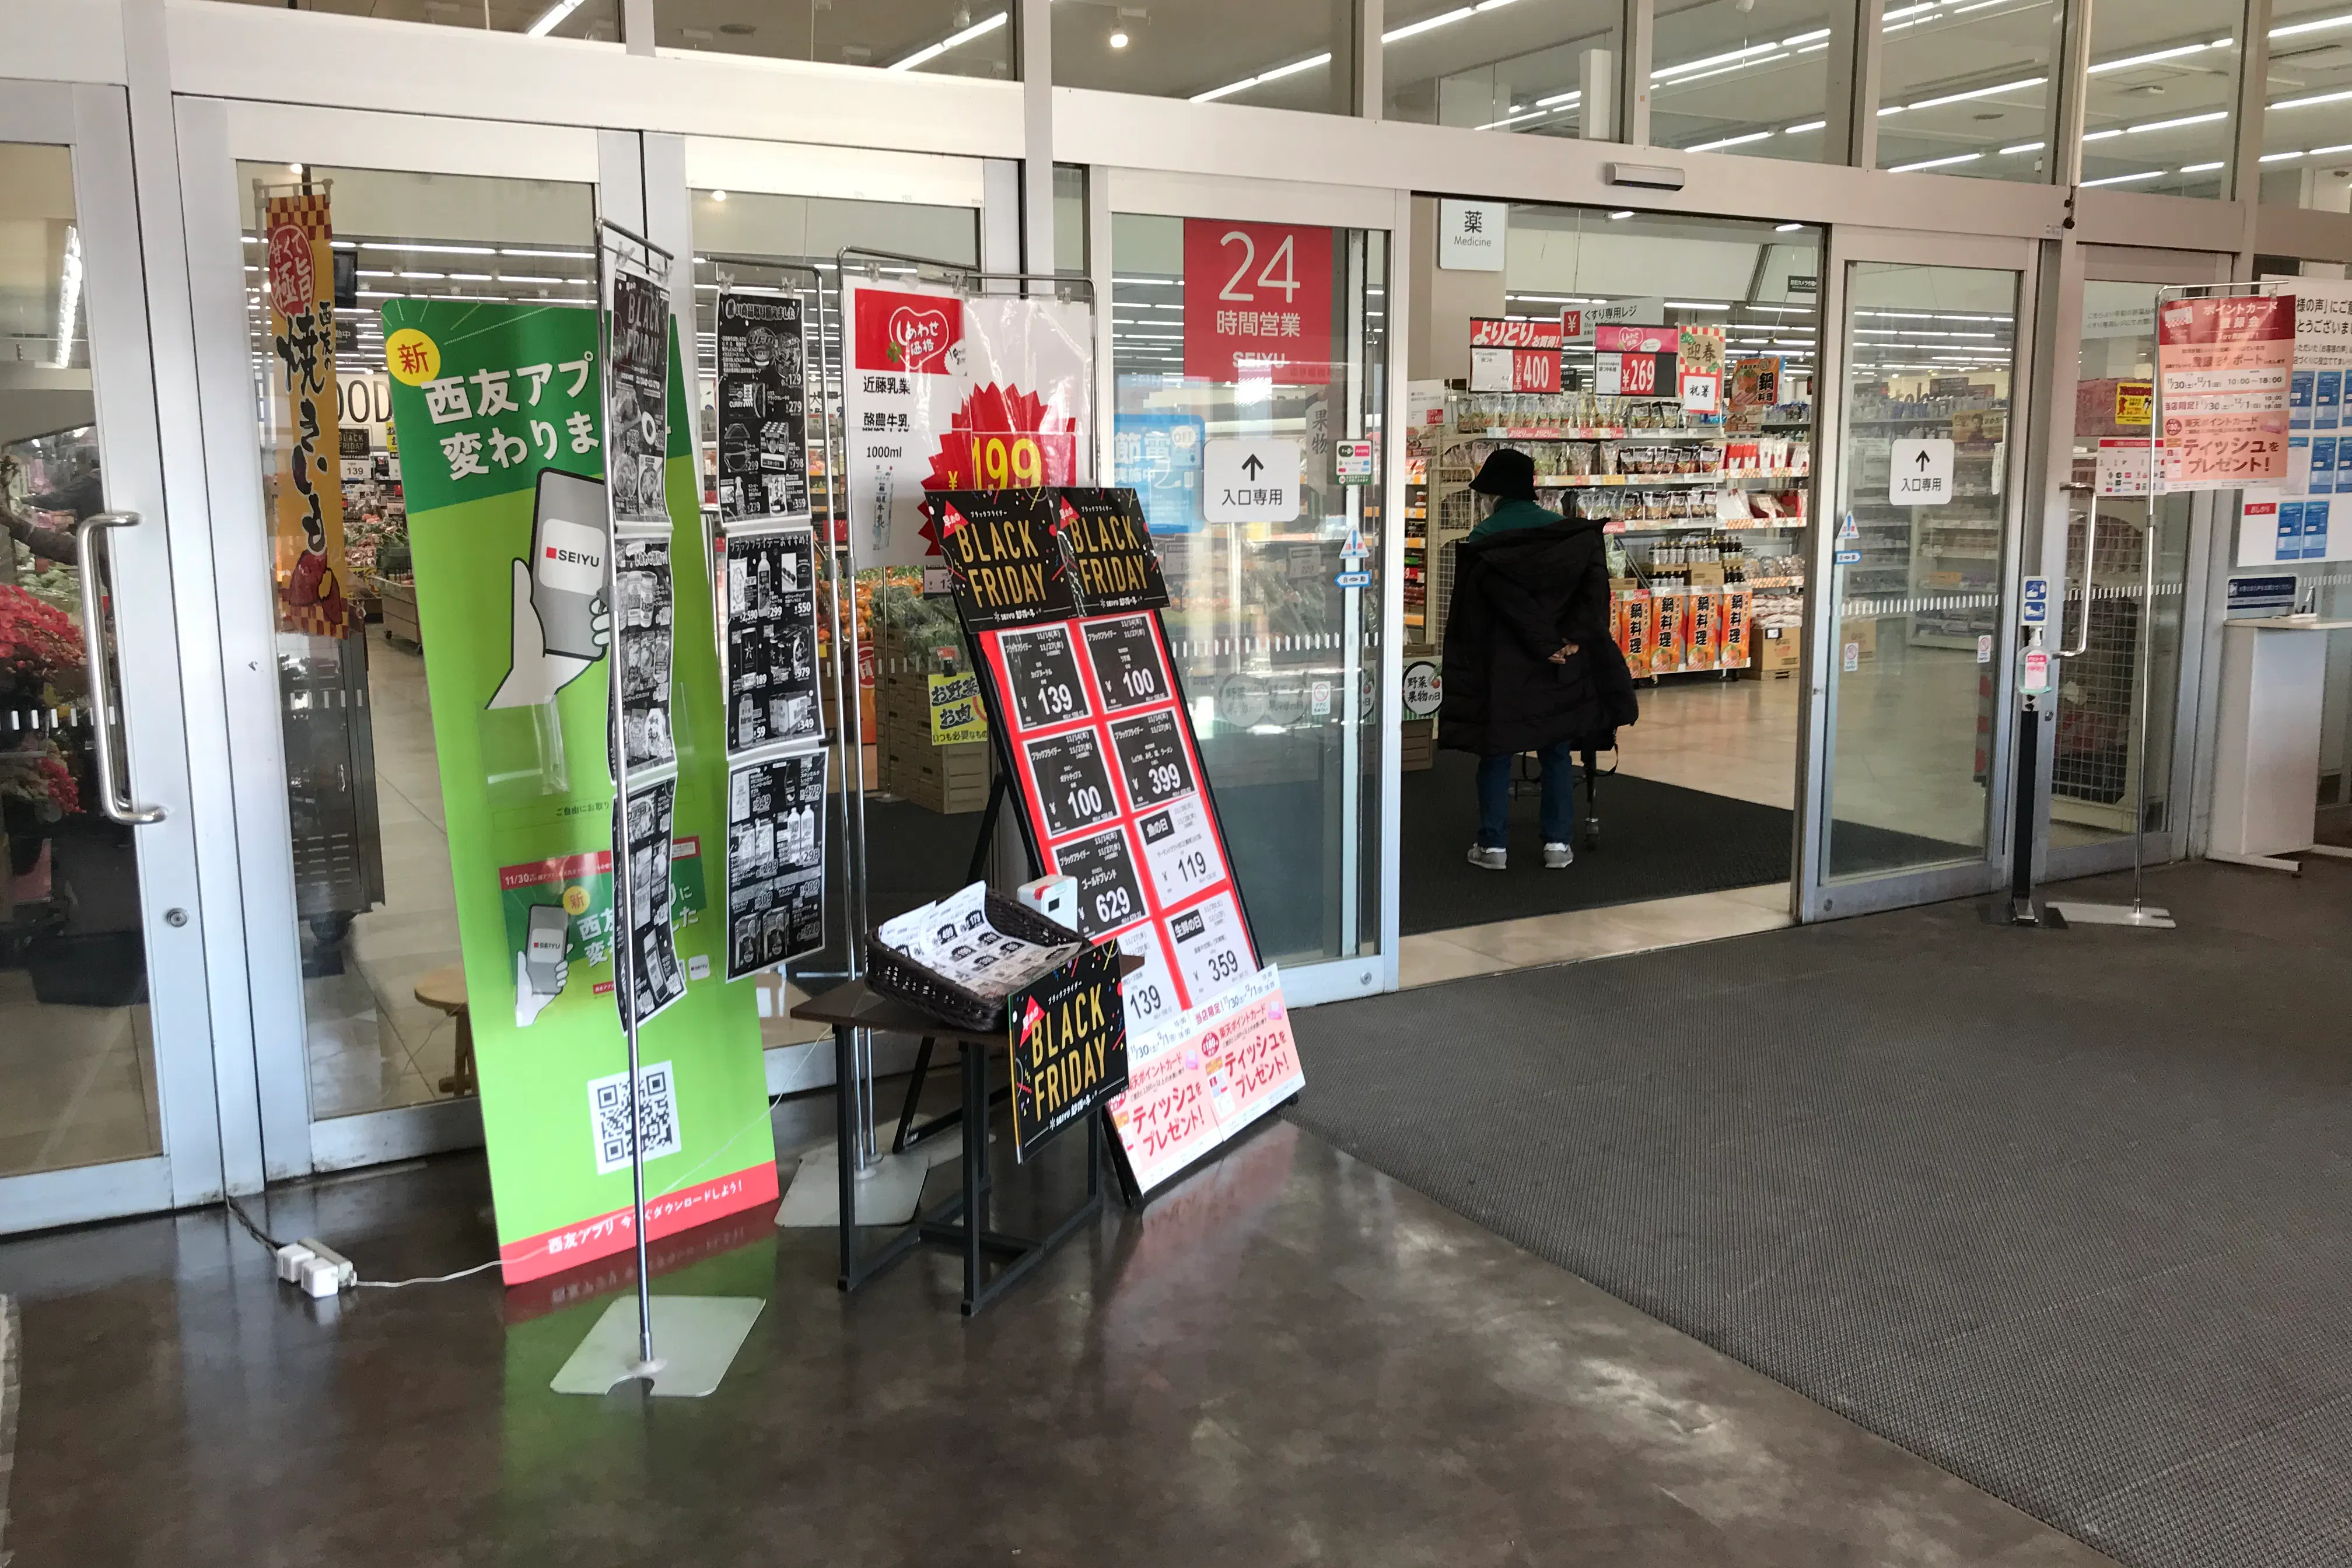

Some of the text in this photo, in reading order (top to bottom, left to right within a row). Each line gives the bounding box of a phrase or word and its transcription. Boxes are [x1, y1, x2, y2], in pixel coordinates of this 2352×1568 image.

[1464, 210, 1482, 234] 薬
[1454, 235, 1492, 247] Medicine
[1218, 231, 1301, 303] 24
[628, 293, 660, 334] BLACK
[1216, 310, 1301, 338] 時間営業
[1584, 304, 1638, 321] くすり専用レジ
[2202, 302, 2278, 316] ポイントカード
[896, 320, 939, 346] しあわせ
[911, 339, 935, 355] 価格
[1473, 321, 1560, 348] よりどり お買得!
[397, 342, 429, 374] 新
[1232, 351, 1286, 369] SEIYU
[1686, 342, 1717, 363] 迎春
[2192, 354, 2264, 368] 登録をポート
[863, 376, 911, 396] 近藤乳業
[1523, 355, 1549, 388] 400
[1630, 359, 1656, 391] 269
[1758, 372, 1774, 391] 鍋
[421, 351, 594, 424] 西友アプ
[1758, 393, 1773, 402] 料理
[276, 306, 328, 552] 焼きいも
[863, 412, 910, 429] 酪農牛乳
[1311, 408, 1329, 456] 果物
[440, 411, 600, 481] 変わりま
[866, 446, 902, 458] 1000ml
[1114, 430, 1172, 466] 節電
[2183, 438, 2280, 457] ティッシュを
[792, 459, 804, 468] 798
[972, 438, 1042, 490] 199
[2189, 456, 2270, 474] プレゼント!
[1221, 488, 1283, 506] 入口専用
[1900, 478, 1942, 492] 入口専用
[793, 499, 806, 509] 359
[954, 519, 1039, 564] BLACK
[1068, 516, 1141, 554] BLACK
[558, 550, 600, 568] SEIYU
[968, 562, 1047, 608] FRIDAY
[1078, 555, 1148, 595] FRIDAY
[770, 606, 783, 617] 299
[797, 601, 811, 614] 550
[1658, 595, 1674, 648] 鍋料理
[1695, 595, 1710, 646] 鍋料理
[1728, 594, 1743, 643] 鍋料理
[1629, 603, 1643, 654] 鍋料理
[931, 676, 981, 704] お野菜
[1122, 668, 1155, 698] 100
[1407, 676, 1428, 689] 野菜
[1408, 690, 1441, 703] 果物の日
[940, 704, 972, 727] お肉
[1038, 684, 1073, 716] 139
[1148, 762, 1181, 794] 399
[555, 802, 610, 817] ご自由にお取り
[1067, 785, 1102, 819] 100
[1178, 850, 1206, 883] 119
[569, 891, 584, 910] 新
[1096, 886, 1130, 923] 629
[1174, 916, 1203, 937] 生鮮の日
[1208, 950, 1239, 982] 359
[1129, 984, 1161, 1020] 139
[1195, 1000, 1225, 1026] 当店限定!
[1031, 982, 1106, 1068] BLACK
[1219, 1003, 1266, 1039] 楽天ポイントカード
[1224, 1029, 1287, 1078] ティッシュを
[1034, 1032, 1107, 1122] FRIDAY
[1234, 1054, 1290, 1098] プレゼント!
[1132, 1080, 1202, 1134] ティッシュを
[1142, 1104, 1205, 1157] プレゼント!
[548, 1179, 743, 1254] 西友アプリ 今ぐダウンロードしよう!
